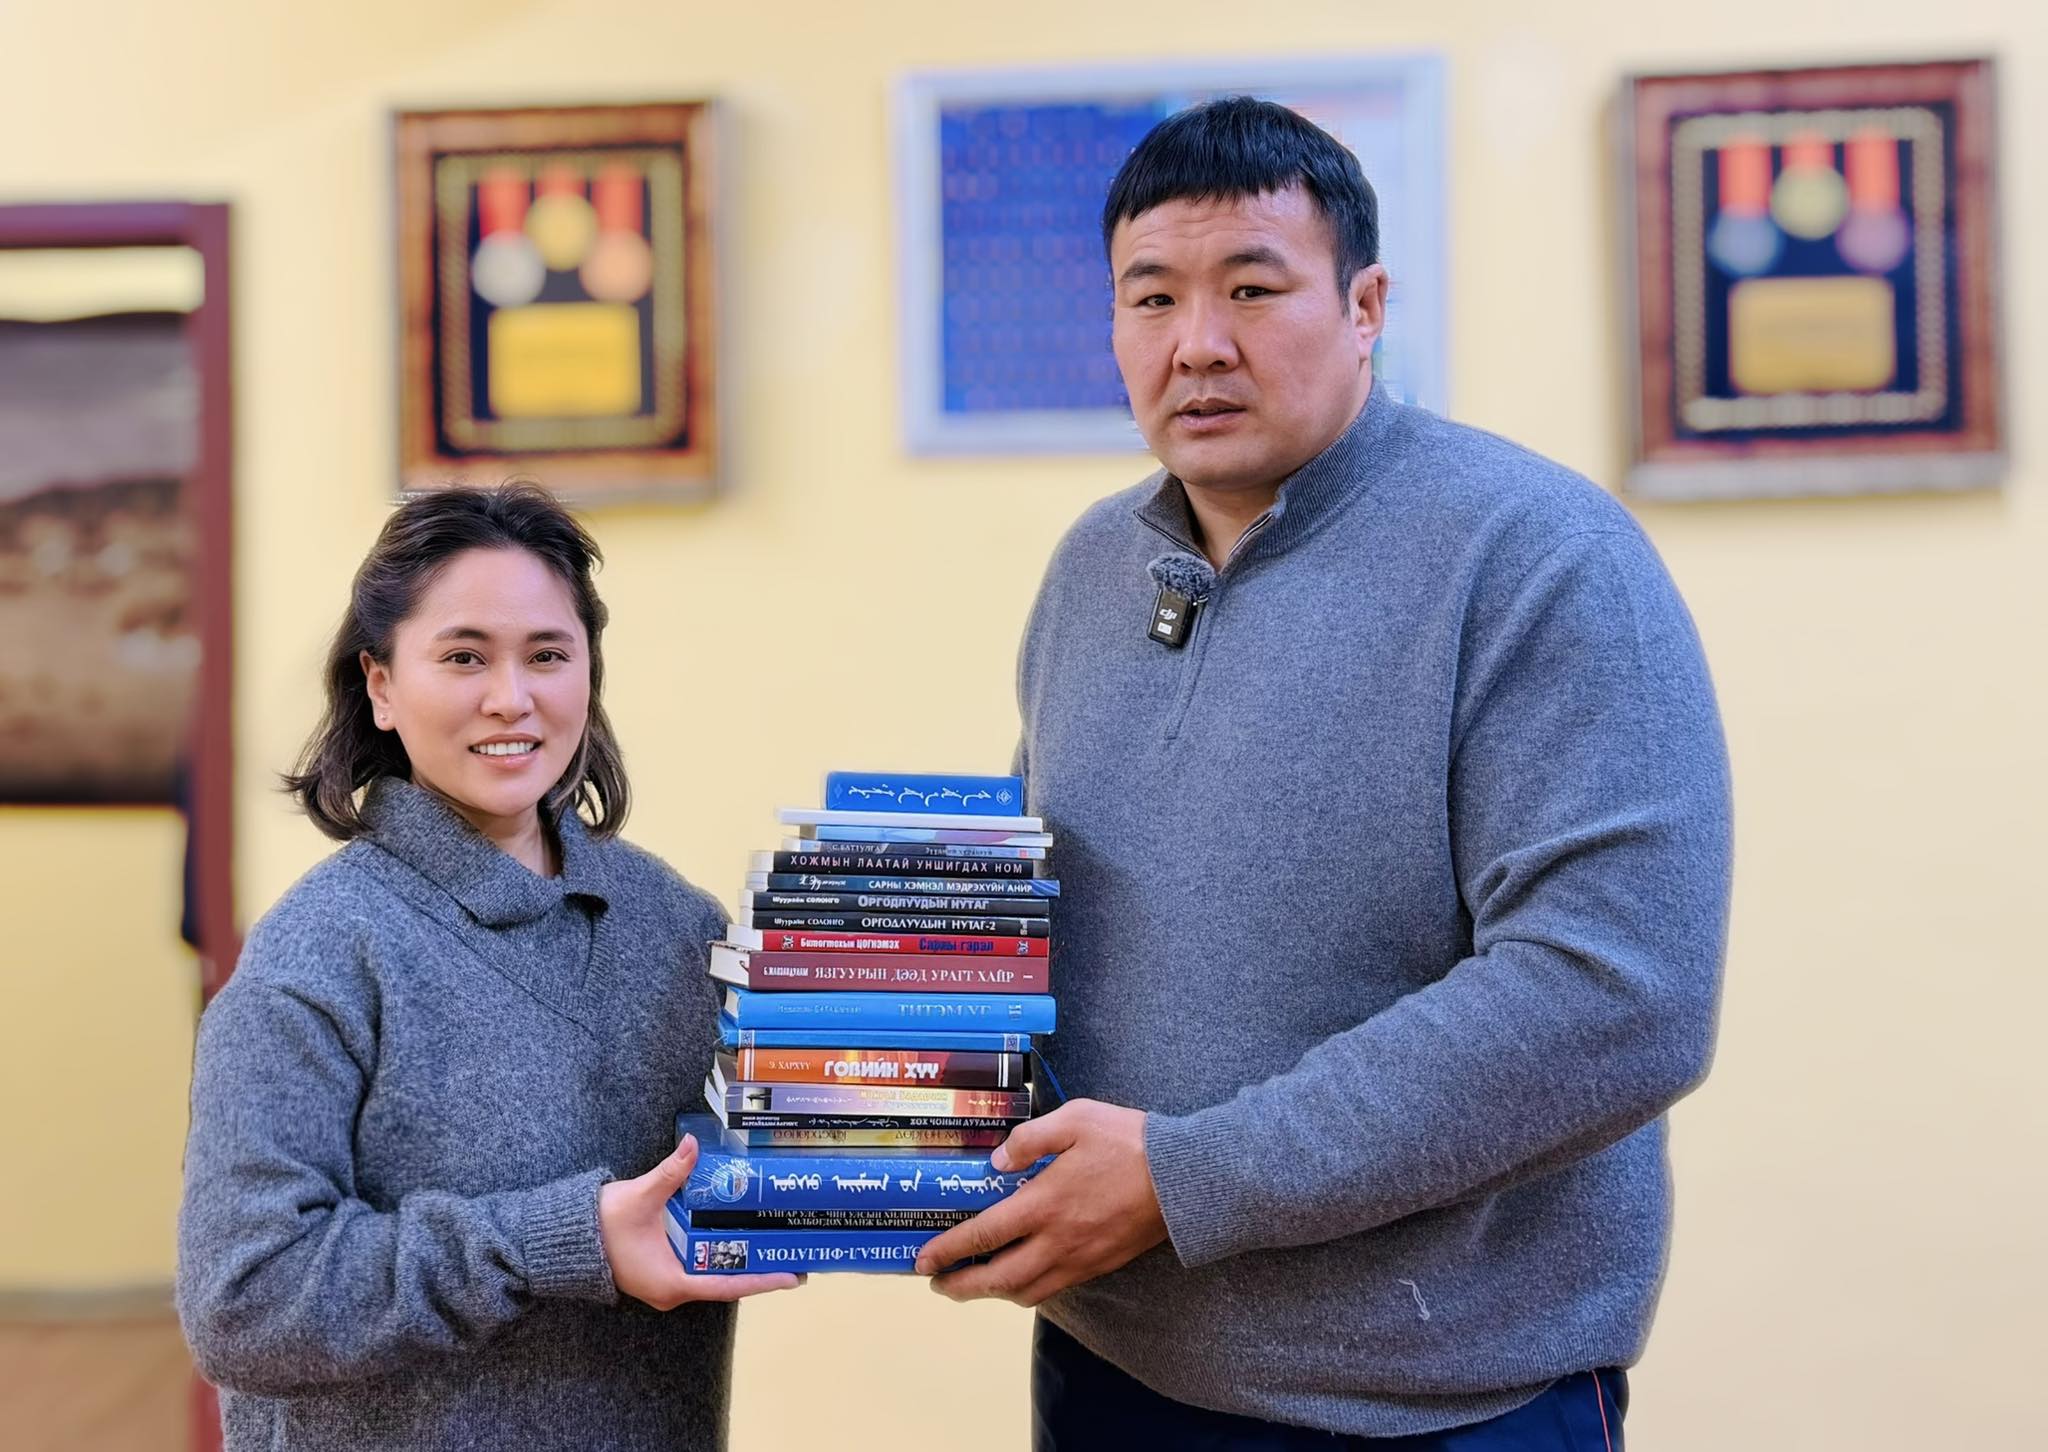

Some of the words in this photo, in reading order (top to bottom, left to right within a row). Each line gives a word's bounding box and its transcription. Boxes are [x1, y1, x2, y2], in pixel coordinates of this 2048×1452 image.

[1159, 608, 1178, 620] dji
[790, 855, 850, 867] ХОЖМЫН
[857, 858, 910, 869] ЛААТАЙ
[917, 860, 988, 873] УНШИГДАХ
[995, 863, 1022, 874] НОМ
[868, 880, 901, 890] САРНЫ
[904, 881, 944, 891] ХЭМНЭЛ
[946, 882, 1004, 893] МЭДРЭХҮЙН
[1007, 884, 1033, 893] АНИР
[950, 899, 989, 910] НУТАГ
[861, 917, 946, 929] ОРГОДЛУУДЫН
[951, 919, 996, 931] НУТАГ-2
[815, 967, 887, 980] ЯЗГУУРЫН
[931, 969, 974, 982] УРАГТ
[977, 970, 1015, 983] ХАЙР
[824, 1057, 899, 1078] ГОВИЙН
[904, 1062, 940, 1079] ХҮҮ
[756, 1244, 924, 1262] ЭДЭНБАЛ-ФИЛАТОВА
